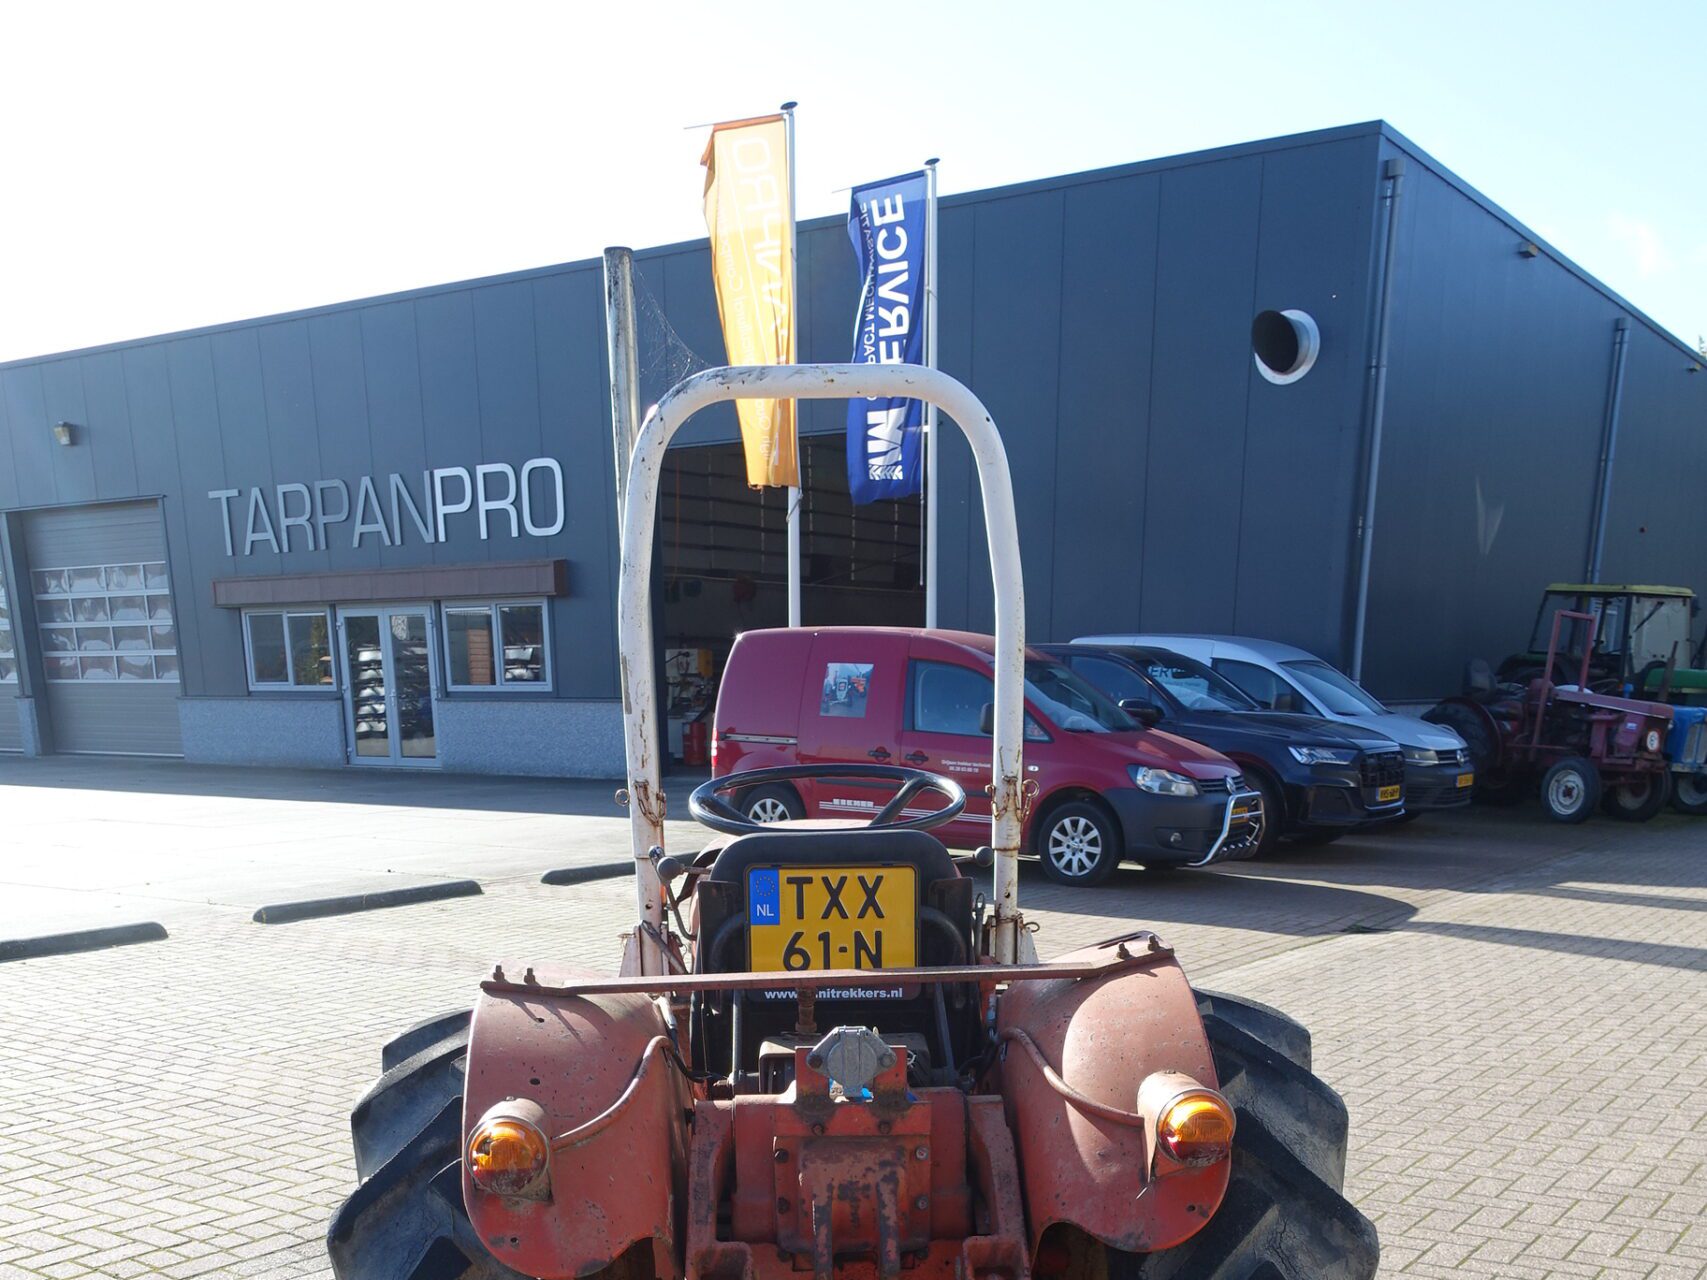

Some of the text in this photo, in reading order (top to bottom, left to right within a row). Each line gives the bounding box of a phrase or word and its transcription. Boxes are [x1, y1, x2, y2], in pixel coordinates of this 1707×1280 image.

[208, 457, 565, 557] TARPANPRO
[756, 904, 775, 917] NL
[786, 875, 885, 920] TXX
[782, 930, 883, 971] 61-N
[764, 987, 903, 999] wwwnitrekkers.nl
